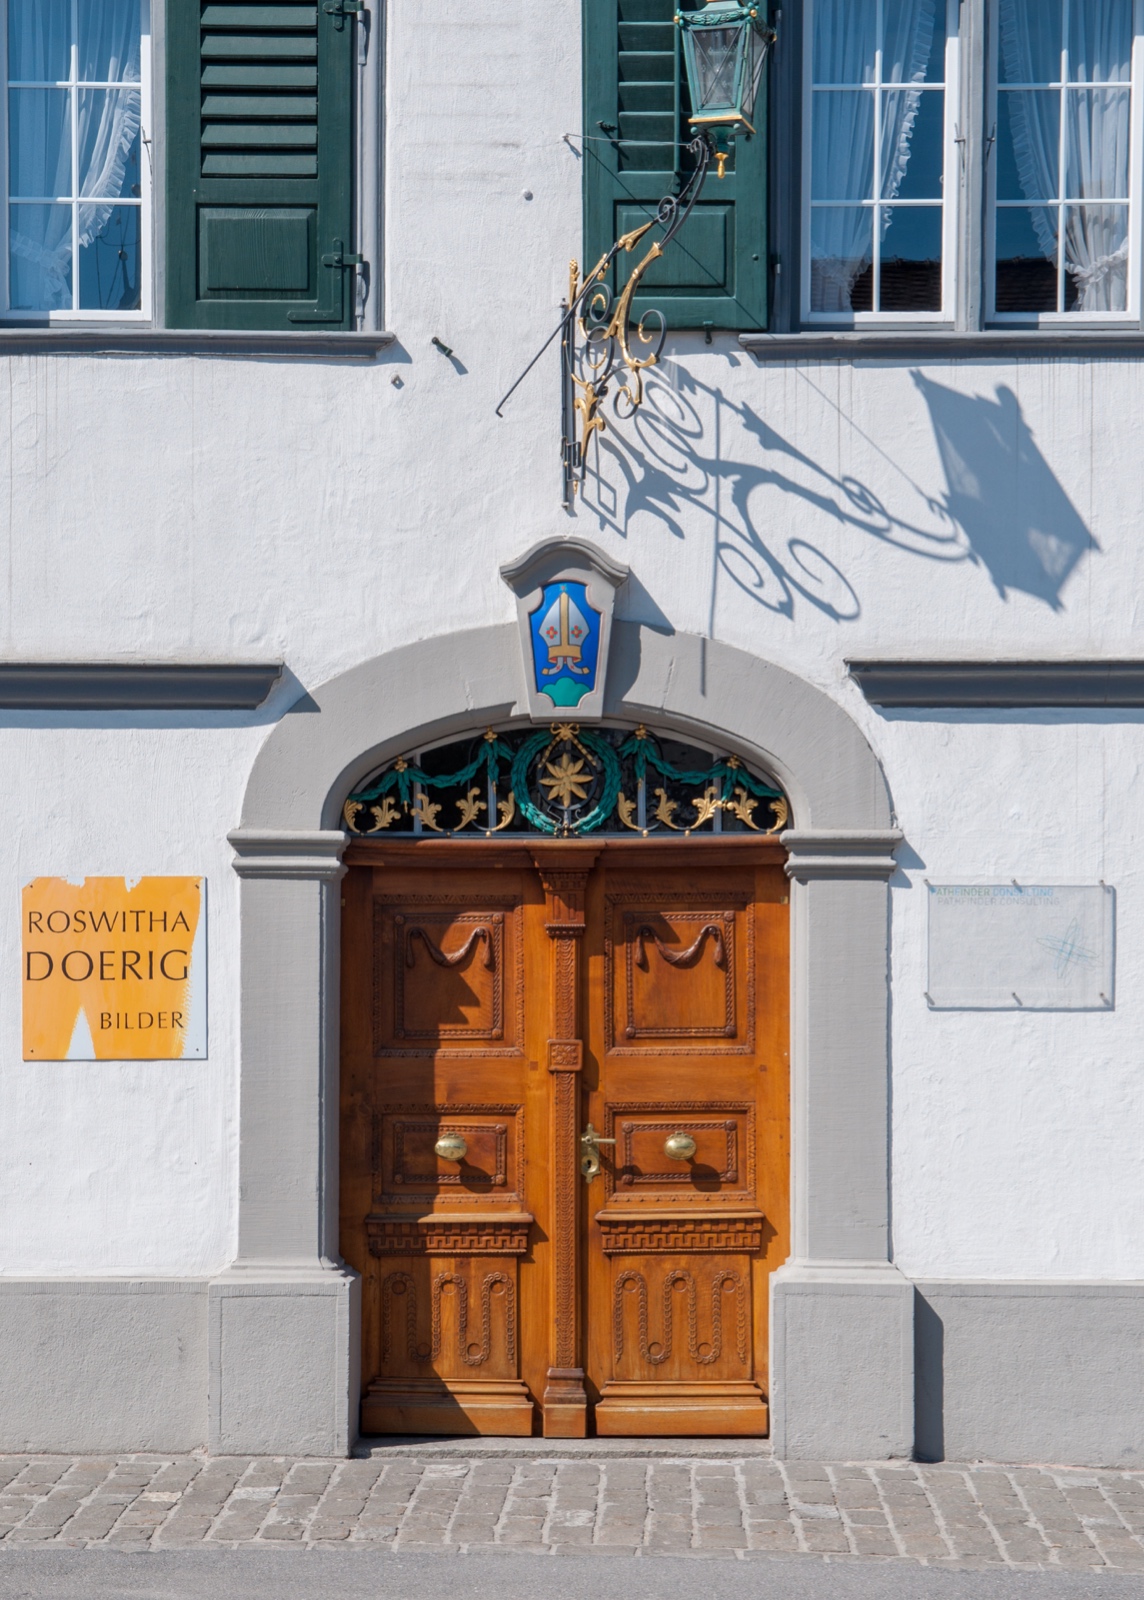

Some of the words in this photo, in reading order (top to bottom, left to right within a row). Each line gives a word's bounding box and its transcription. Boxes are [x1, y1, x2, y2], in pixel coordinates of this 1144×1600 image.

[28, 910, 190, 933] ROSWITHA
[26, 949, 188, 981] DOERIG
[100, 1011, 184, 1029] BILDER
